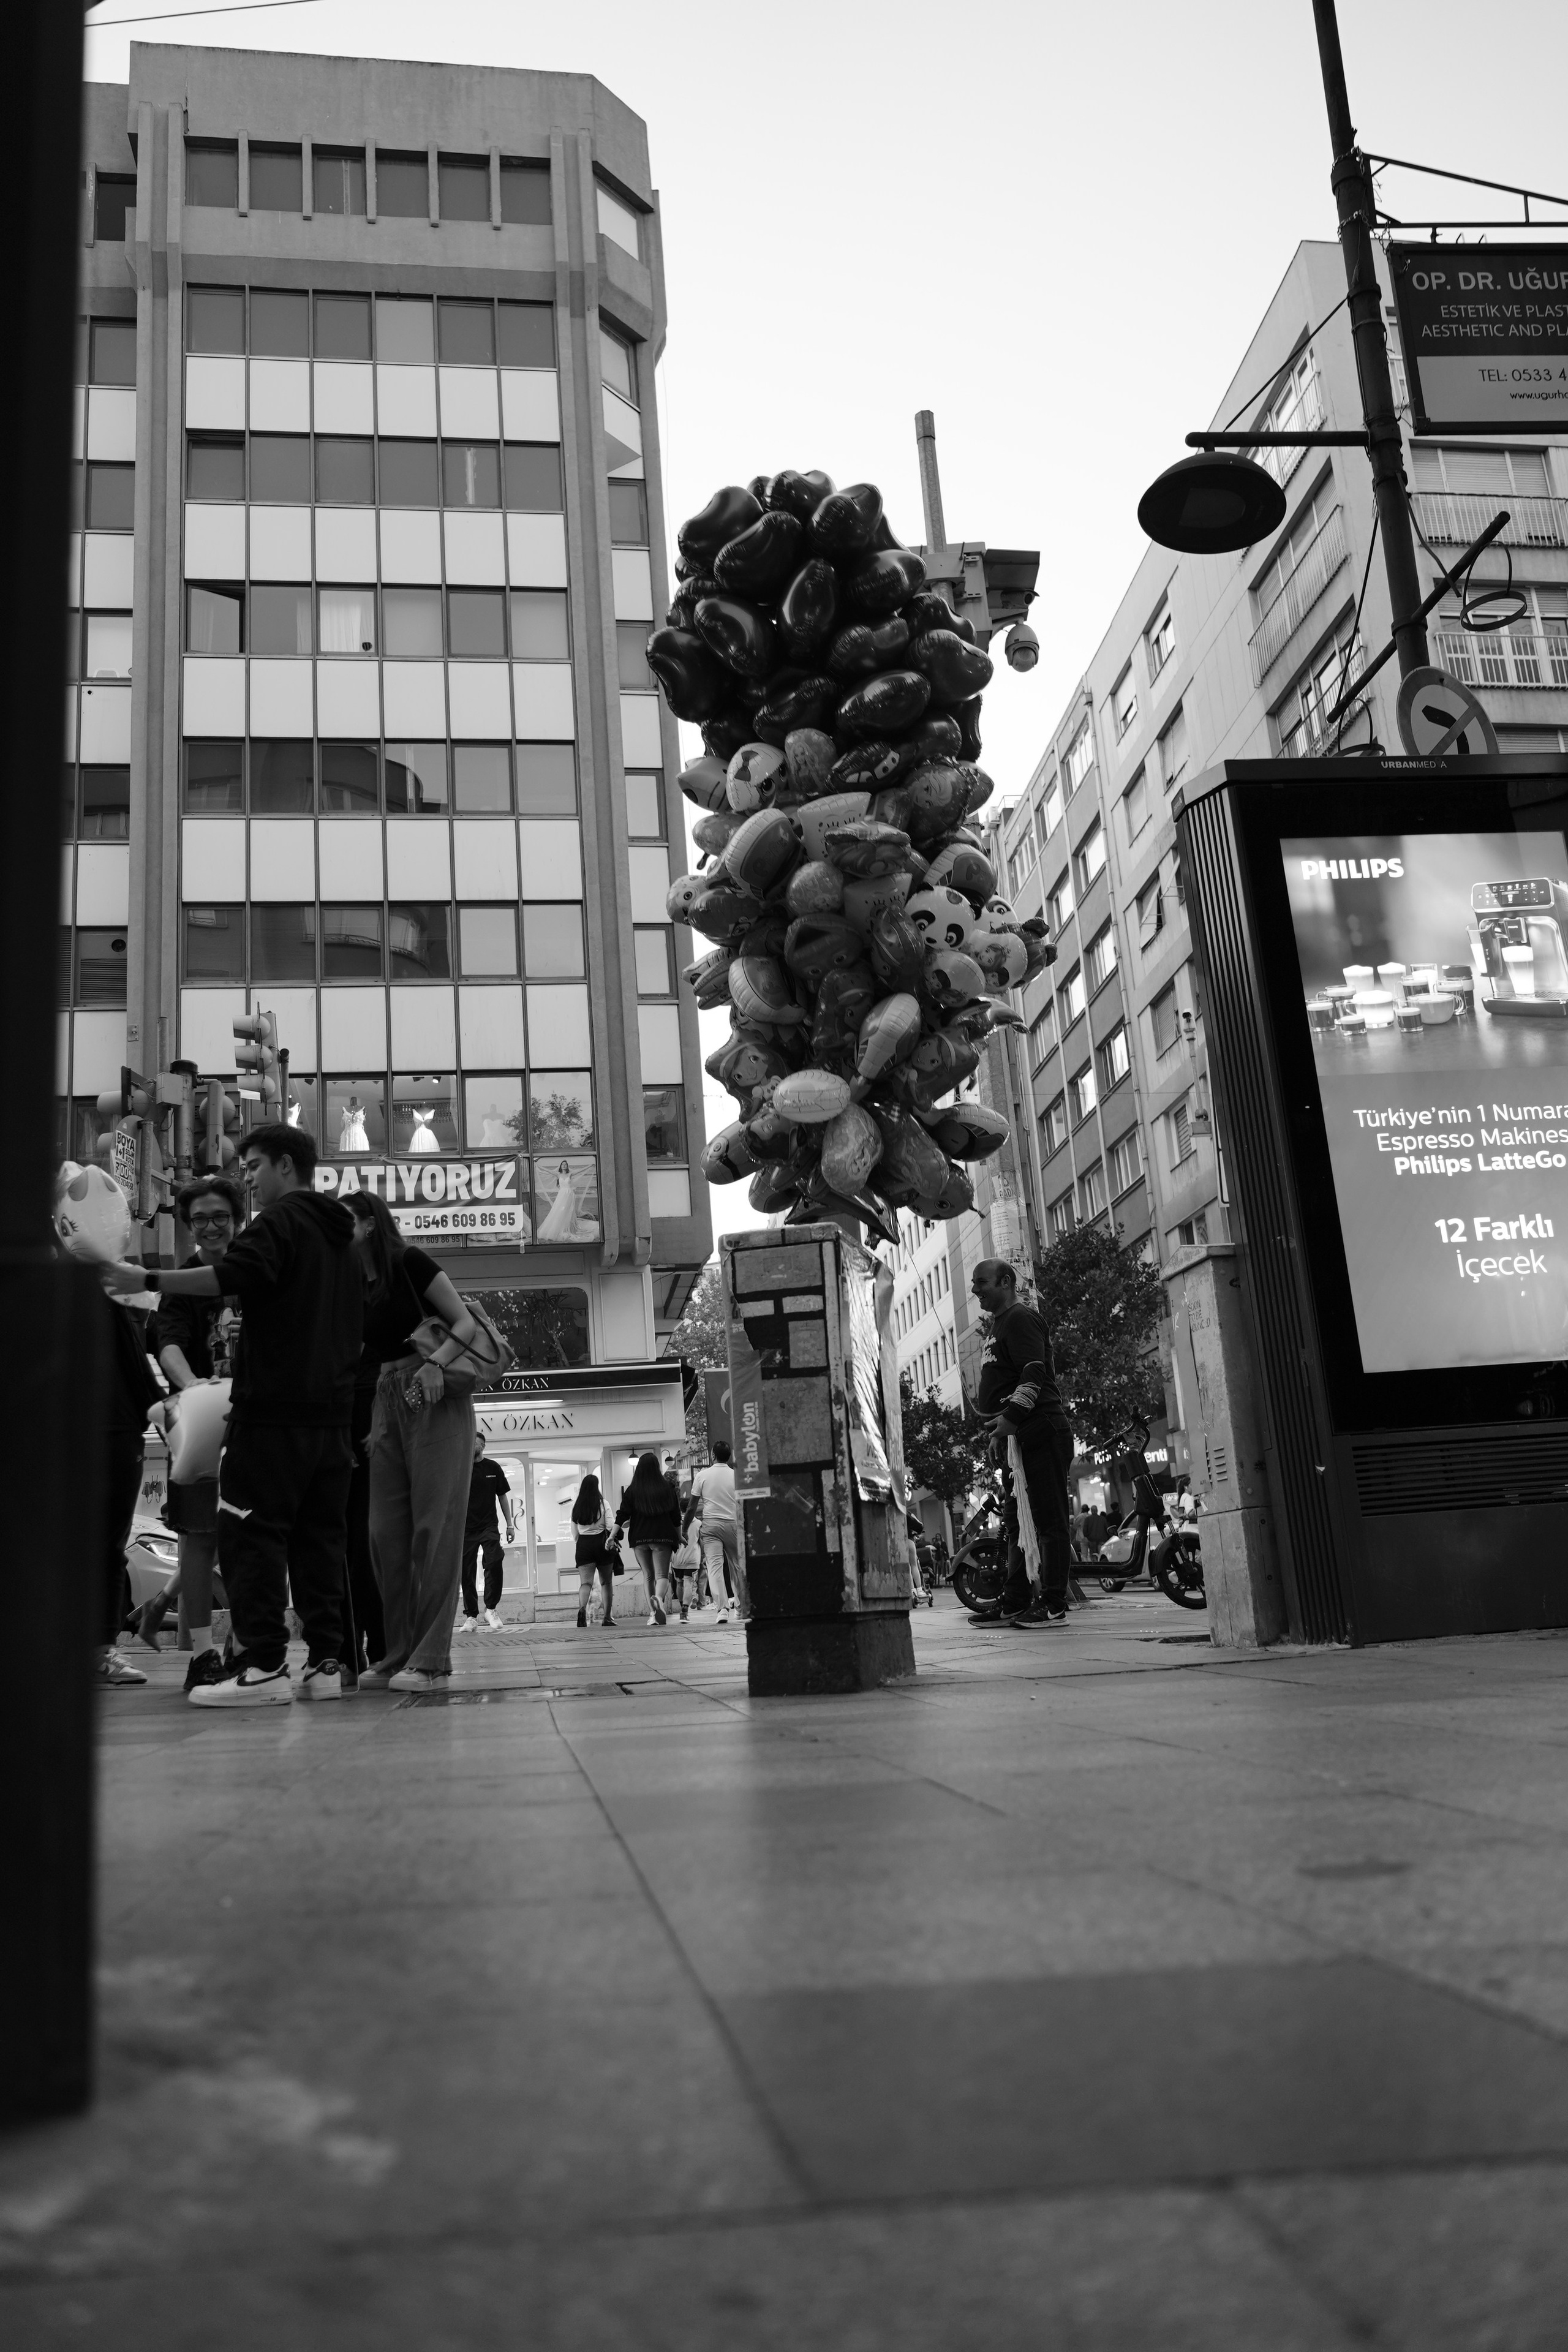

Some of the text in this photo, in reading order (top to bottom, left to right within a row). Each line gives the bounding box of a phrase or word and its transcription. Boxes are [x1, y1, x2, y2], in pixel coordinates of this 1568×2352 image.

[1412, 272, 1450, 290] OP.
[1458, 271, 1501, 290] DR.
[1441, 303, 1501, 317] ESTETİK
[1502, 305, 1522, 317] VE
[1422, 324, 1568, 337] AESTHETIC AND PL
[1478, 369, 1507, 382] TEL:
[1511, 369, 1552, 382] 0533
[1301, 858, 1404, 880] PHILIPS
[1477, 1104, 1486, 1121] 1
[117, 1132, 135, 1152] BOYA
[1376, 1132, 1474, 1154] Espresso
[1394, 1150, 1566, 1177] Philips LatteGo
[314, 1161, 517, 1202] PATIYORUZ
[415, 1214, 448, 1229] 0546
[452, 1213, 477, 1228] 609
[480, 1212, 497, 1227] 86
[499, 1211, 516, 1226] 95
[1434, 1213, 1555, 1243] 12 Farklı
[1456, 1249, 1548, 1283] İçecek
[502, 1378, 549, 1390] ÖZKAN
[503, 1412, 574, 1431] ÖZKAN
[741, 1402, 761, 1472] babylon
[1144, 1449, 1168, 1463] enti
